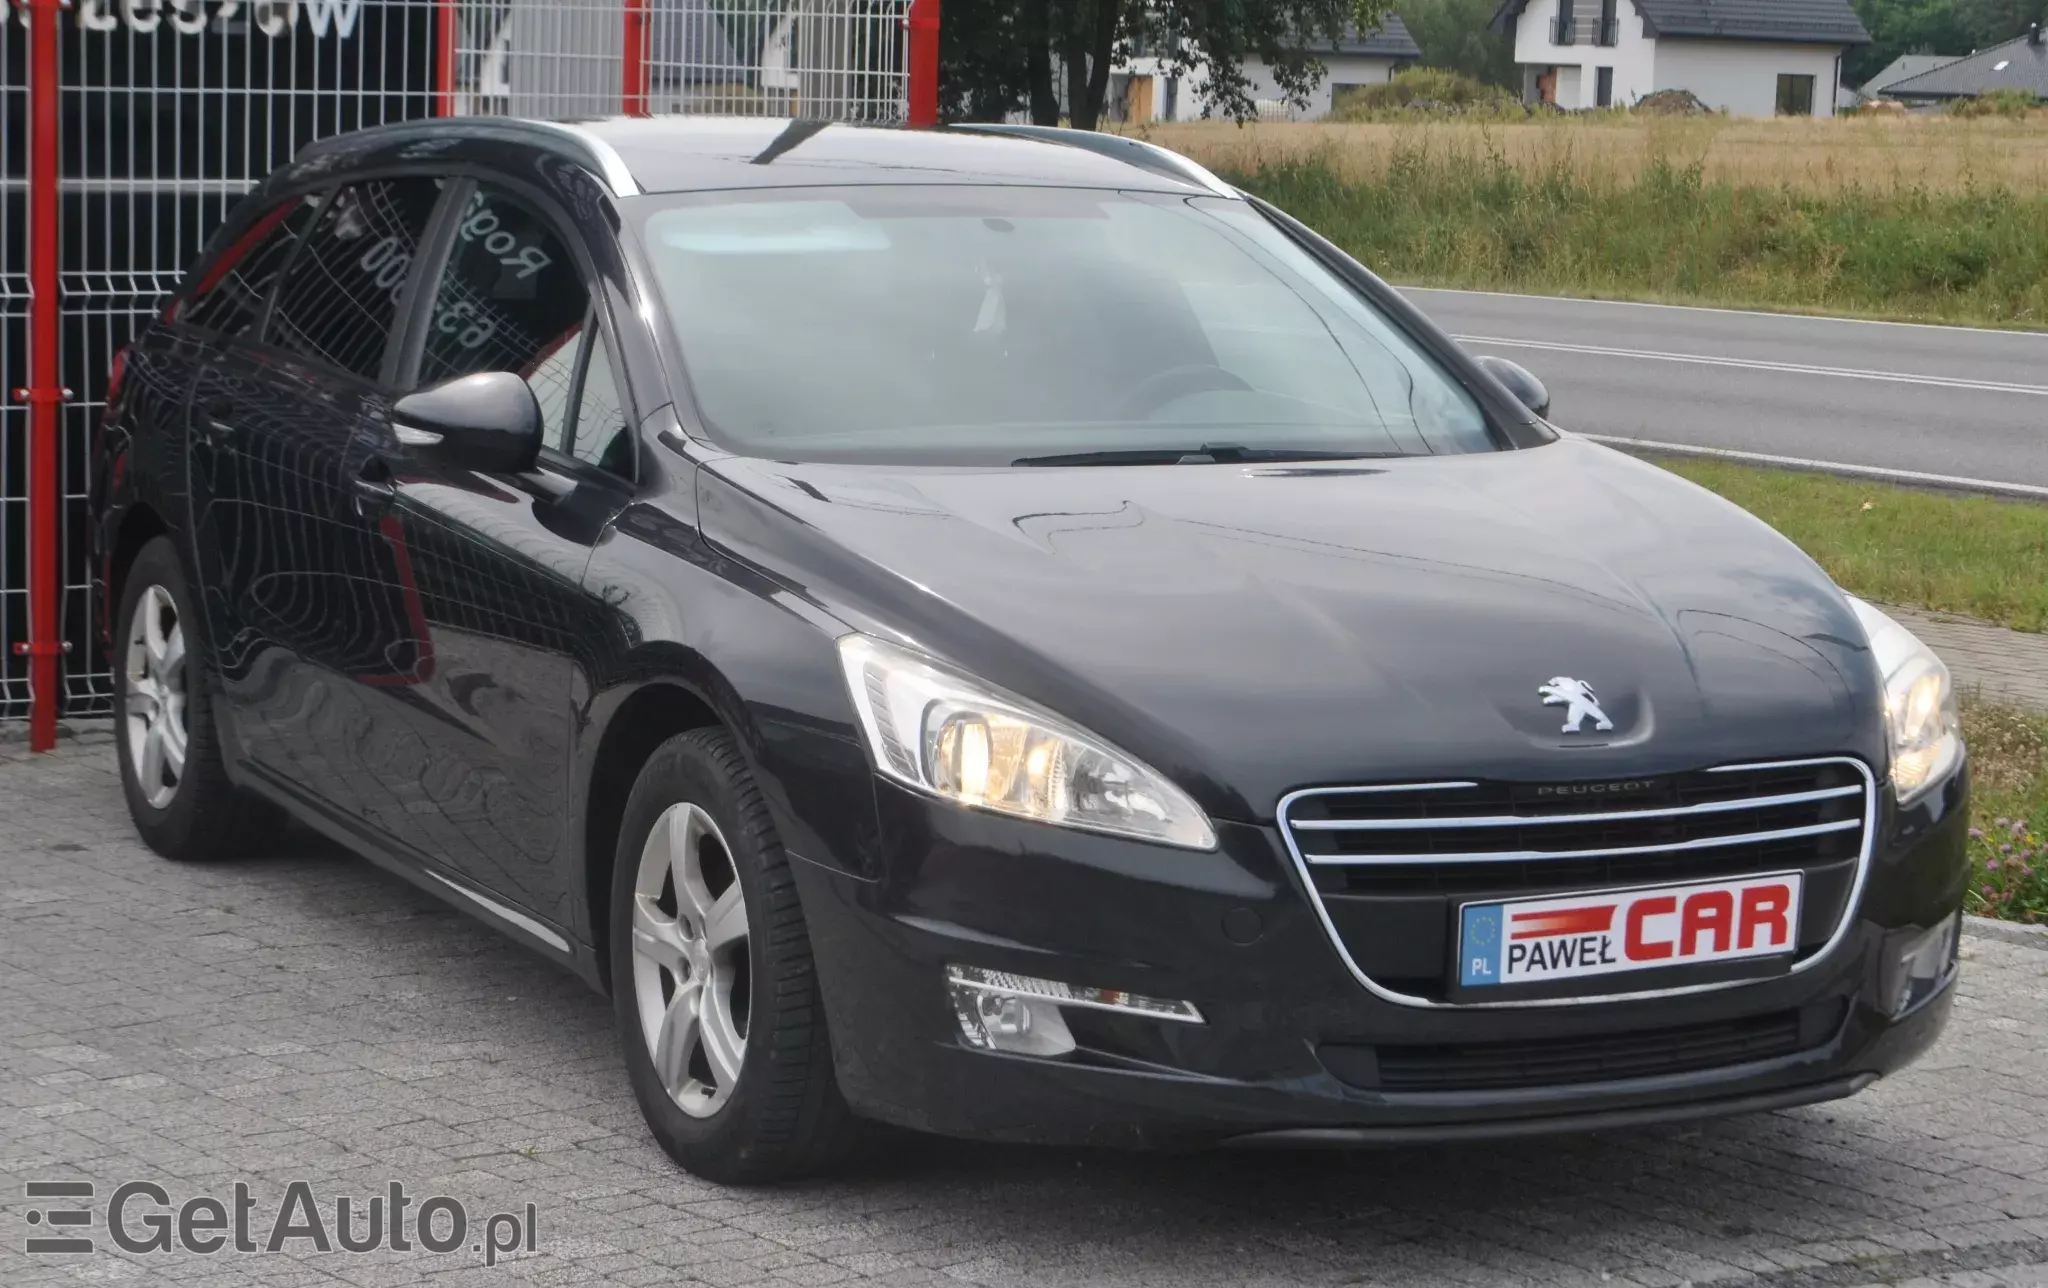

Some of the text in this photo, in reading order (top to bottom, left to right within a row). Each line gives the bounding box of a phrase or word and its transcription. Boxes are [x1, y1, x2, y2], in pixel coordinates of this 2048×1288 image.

[1538, 780, 1654, 795] PEUGEOT
[1507, 884, 1791, 974] PAWEŁ CAR
[1472, 957, 1492, 976] PL
